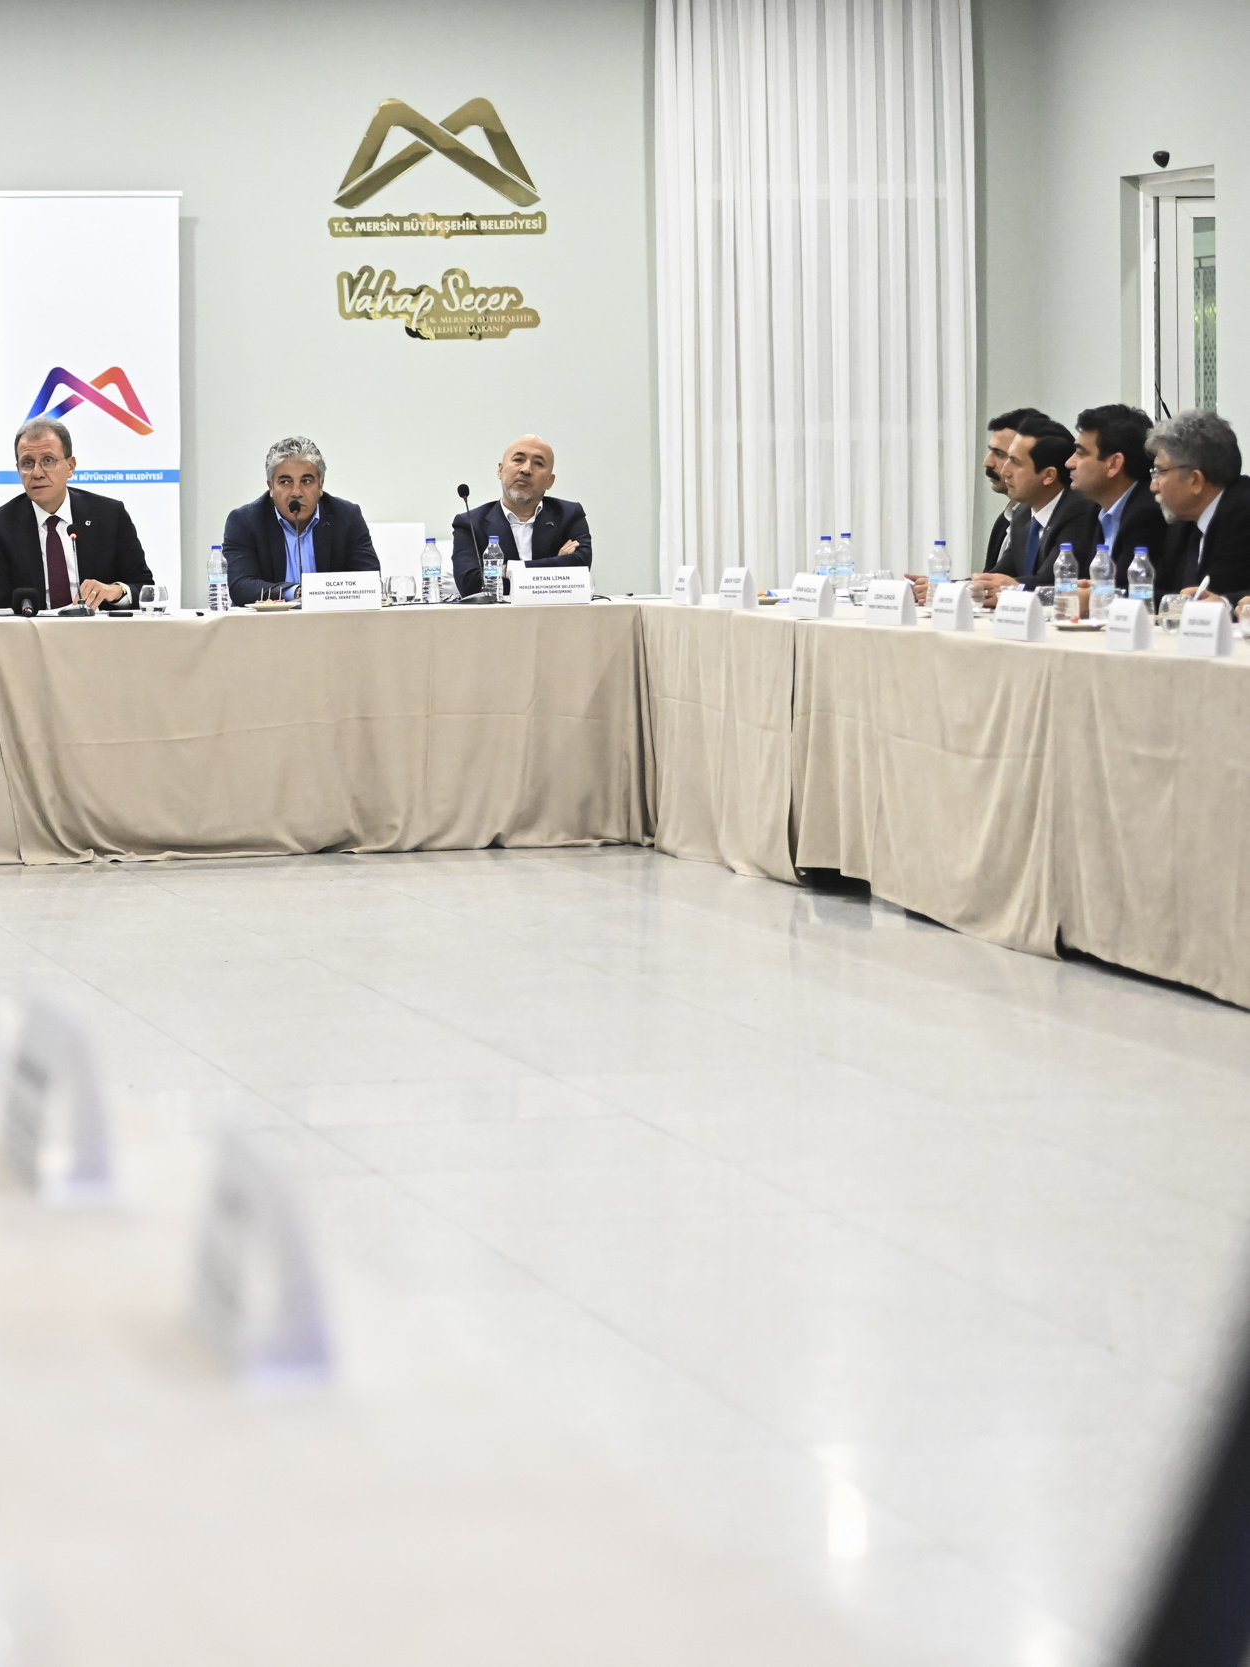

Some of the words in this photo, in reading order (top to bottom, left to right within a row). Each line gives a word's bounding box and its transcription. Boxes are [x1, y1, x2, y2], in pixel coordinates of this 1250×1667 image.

[333, 222, 352, 233] T.C.
[355, 219, 400, 232] MERSİN
[403, 217, 478, 234] BÜYÜKŞEHİR
[480, 216, 542, 230] BELEDİYESİ
[343, 272, 435, 331] Vahap
[442, 275, 517, 314] Seçer
[79, 472, 124, 482] BÜYÜKŞEHİR
[125, 472, 163, 480] BELEDİYESİ
